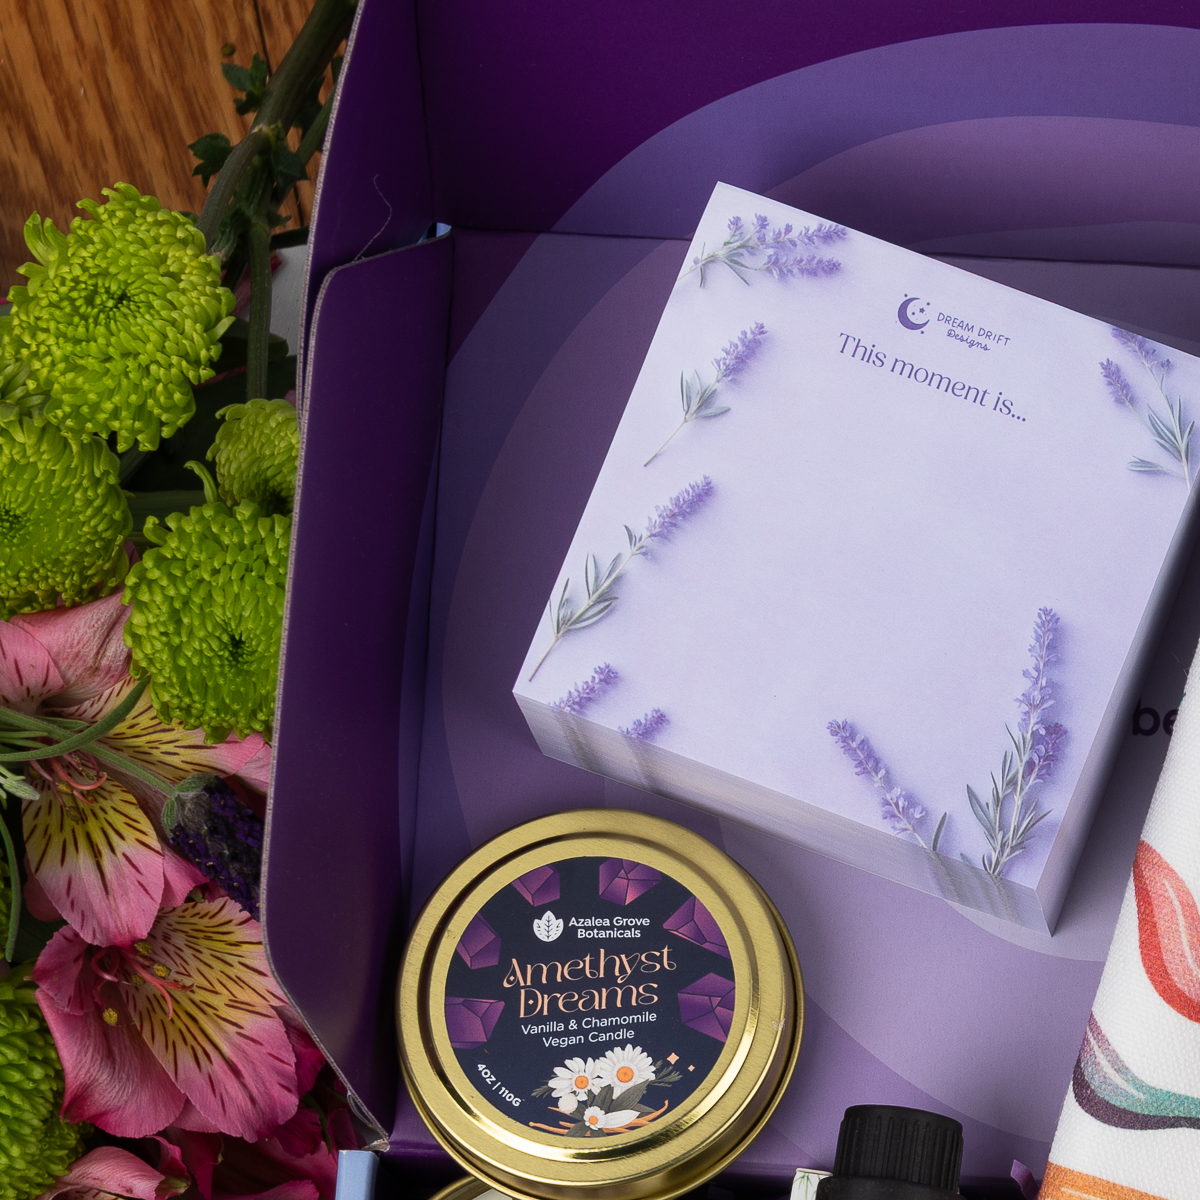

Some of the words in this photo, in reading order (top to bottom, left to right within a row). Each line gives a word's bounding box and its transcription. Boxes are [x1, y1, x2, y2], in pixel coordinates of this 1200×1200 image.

[937, 312, 974, 333] DREAM
[978, 327, 1011, 346] DRIFT
[947, 328, 990, 351] Designs
[839, 332, 887, 368] This
[890, 357, 990, 407] moment
[993, 391, 1026, 422] is...
[568, 916, 611, 927] Azalea
[613, 916, 650, 926] Grove
[577, 928, 641, 939] Botanicals
[503, 944, 677, 989] Amethyst
[519, 982, 659, 1018] Dreams
[521, 1020, 565, 1035] Vanilla
[568, 1019, 578, 1031] &
[582, 1011, 657, 1029] Chamomile
[542, 1033, 584, 1048] Vegan
[588, 1028, 635, 1043] Candle
[498, 1086, 522, 1107] 110G
